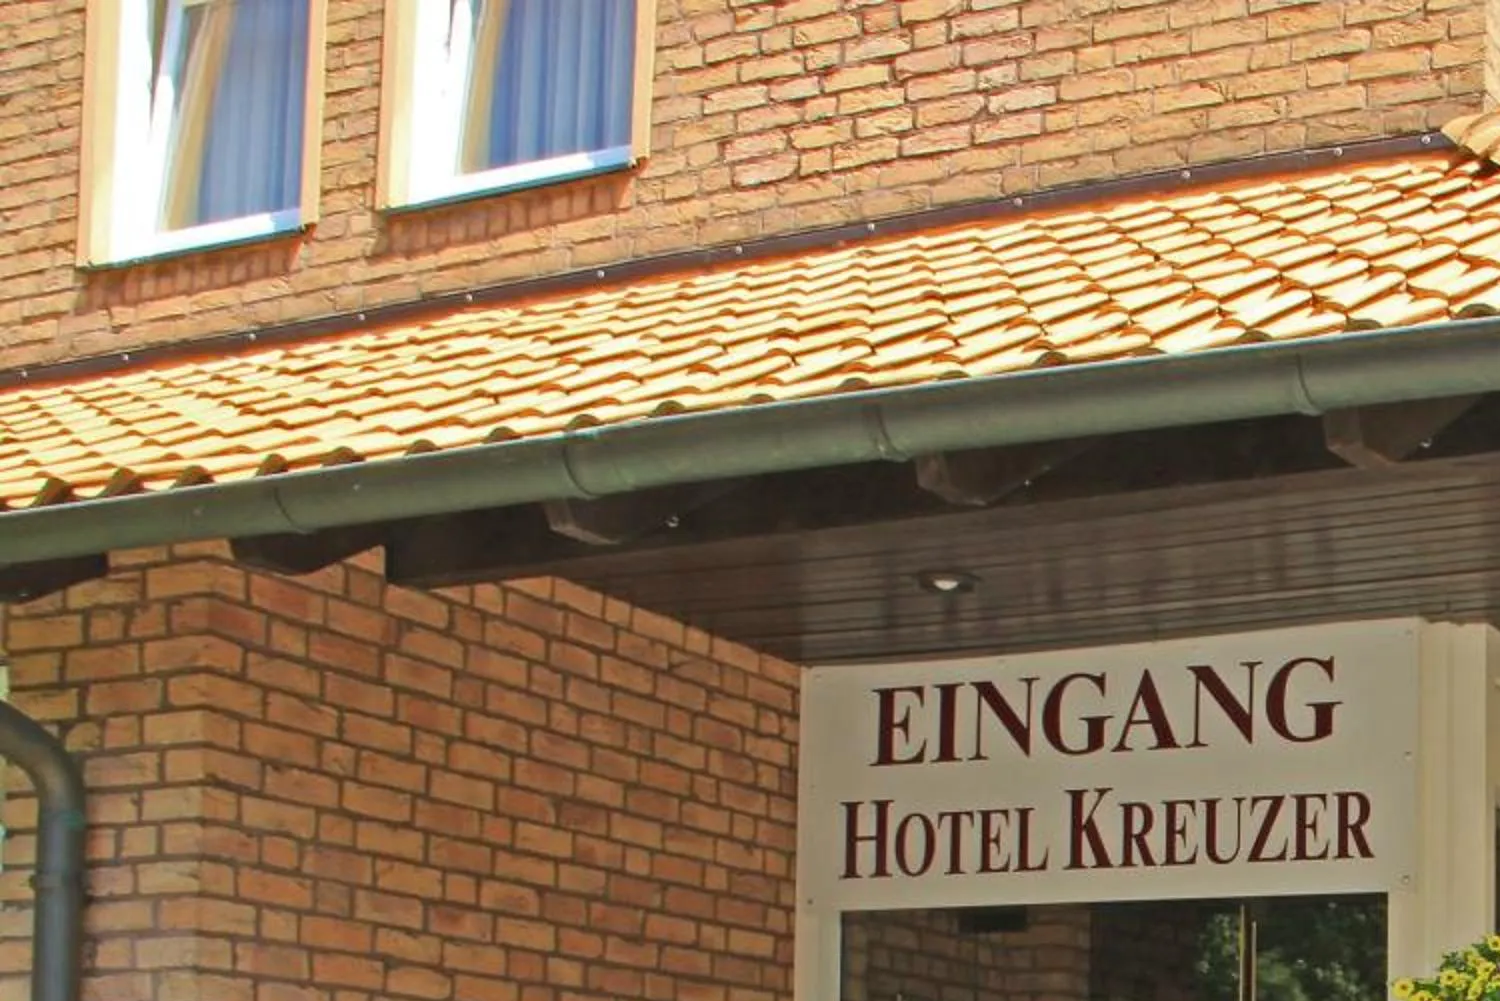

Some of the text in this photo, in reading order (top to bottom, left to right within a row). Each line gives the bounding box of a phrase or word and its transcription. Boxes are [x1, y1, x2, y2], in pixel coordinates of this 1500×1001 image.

[870, 655, 1343, 768] EINGANG
[839, 787, 1375, 880] HOTEL KREUZER
